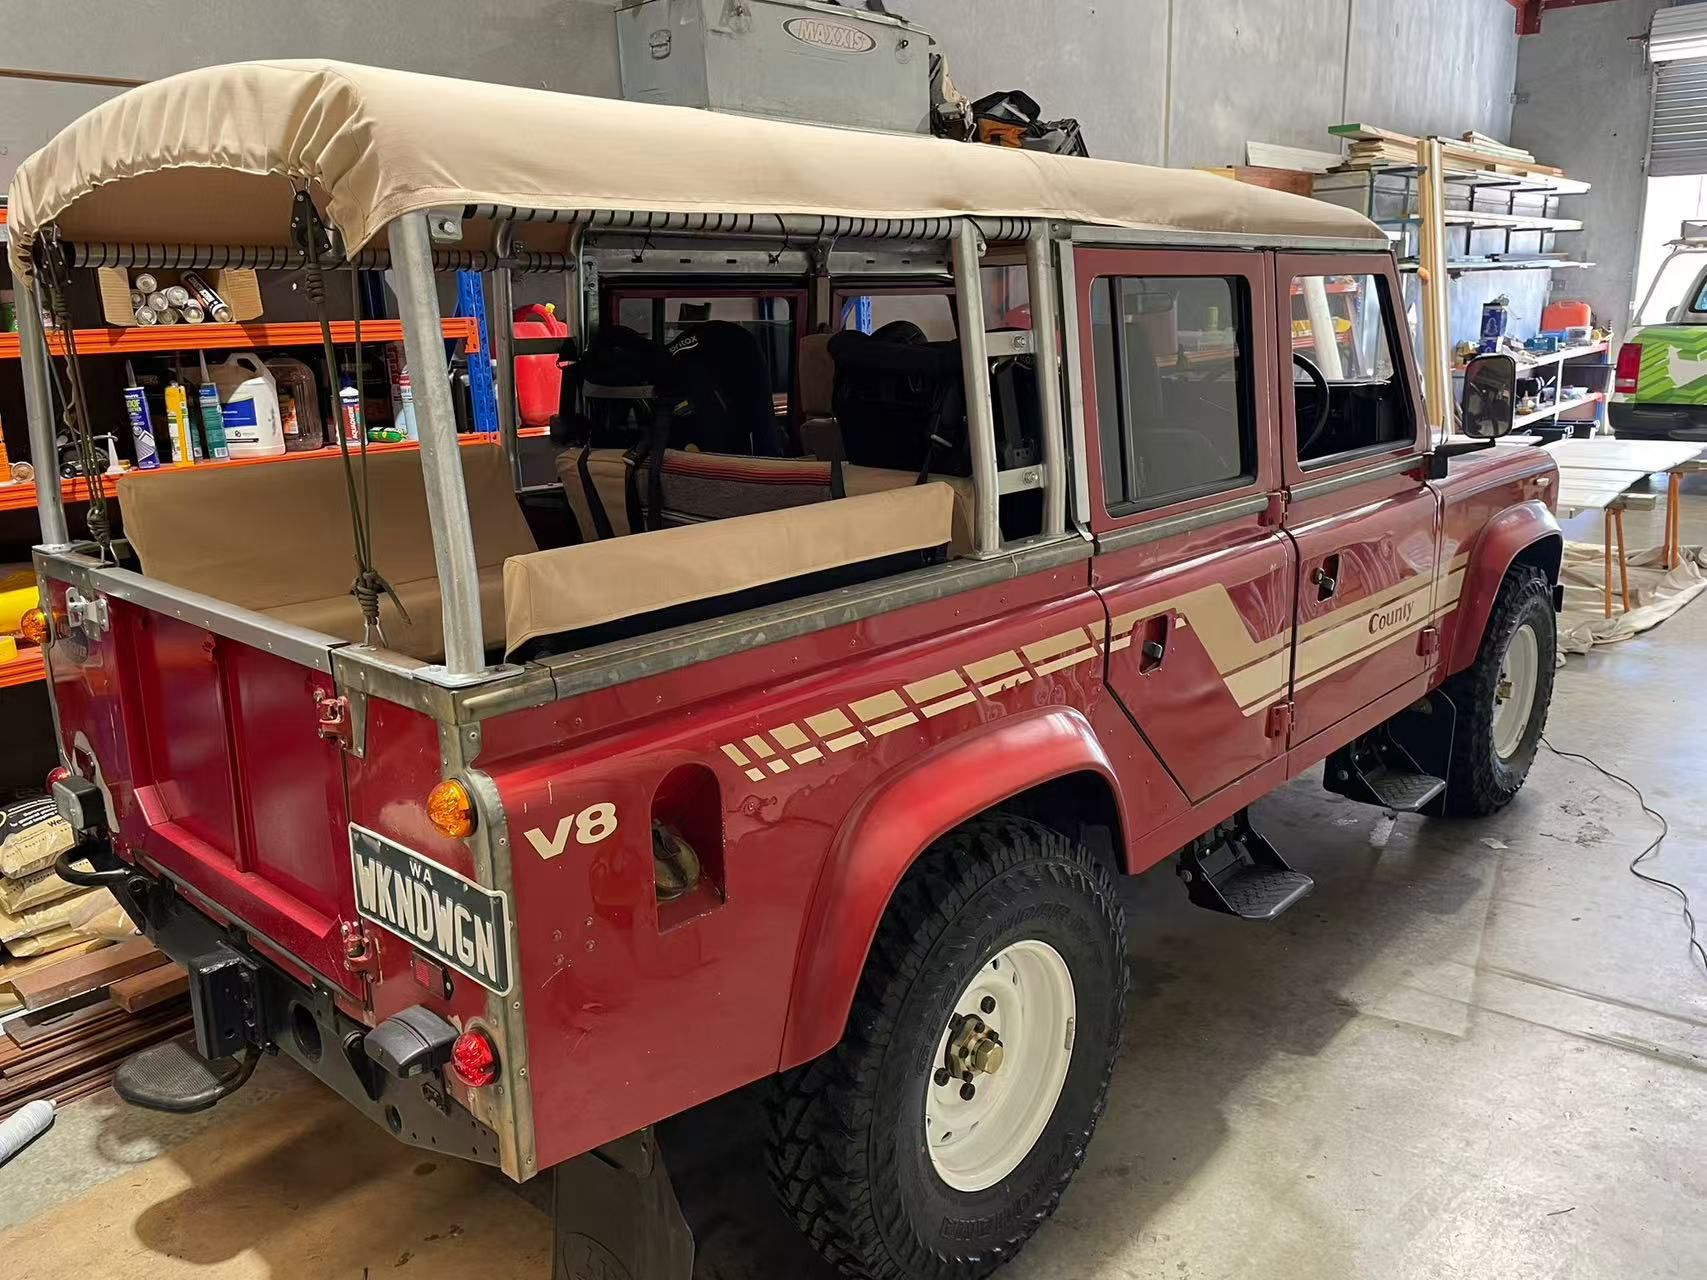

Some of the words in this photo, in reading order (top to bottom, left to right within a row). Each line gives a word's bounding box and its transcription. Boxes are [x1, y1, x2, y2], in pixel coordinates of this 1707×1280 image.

[800, 19, 864, 50] MAXXIS
[1368, 600, 1415, 635] County
[523, 802, 618, 860] V8
[408, 860, 434, 886] WA
[355, 853, 497, 983] WKNDWGN
